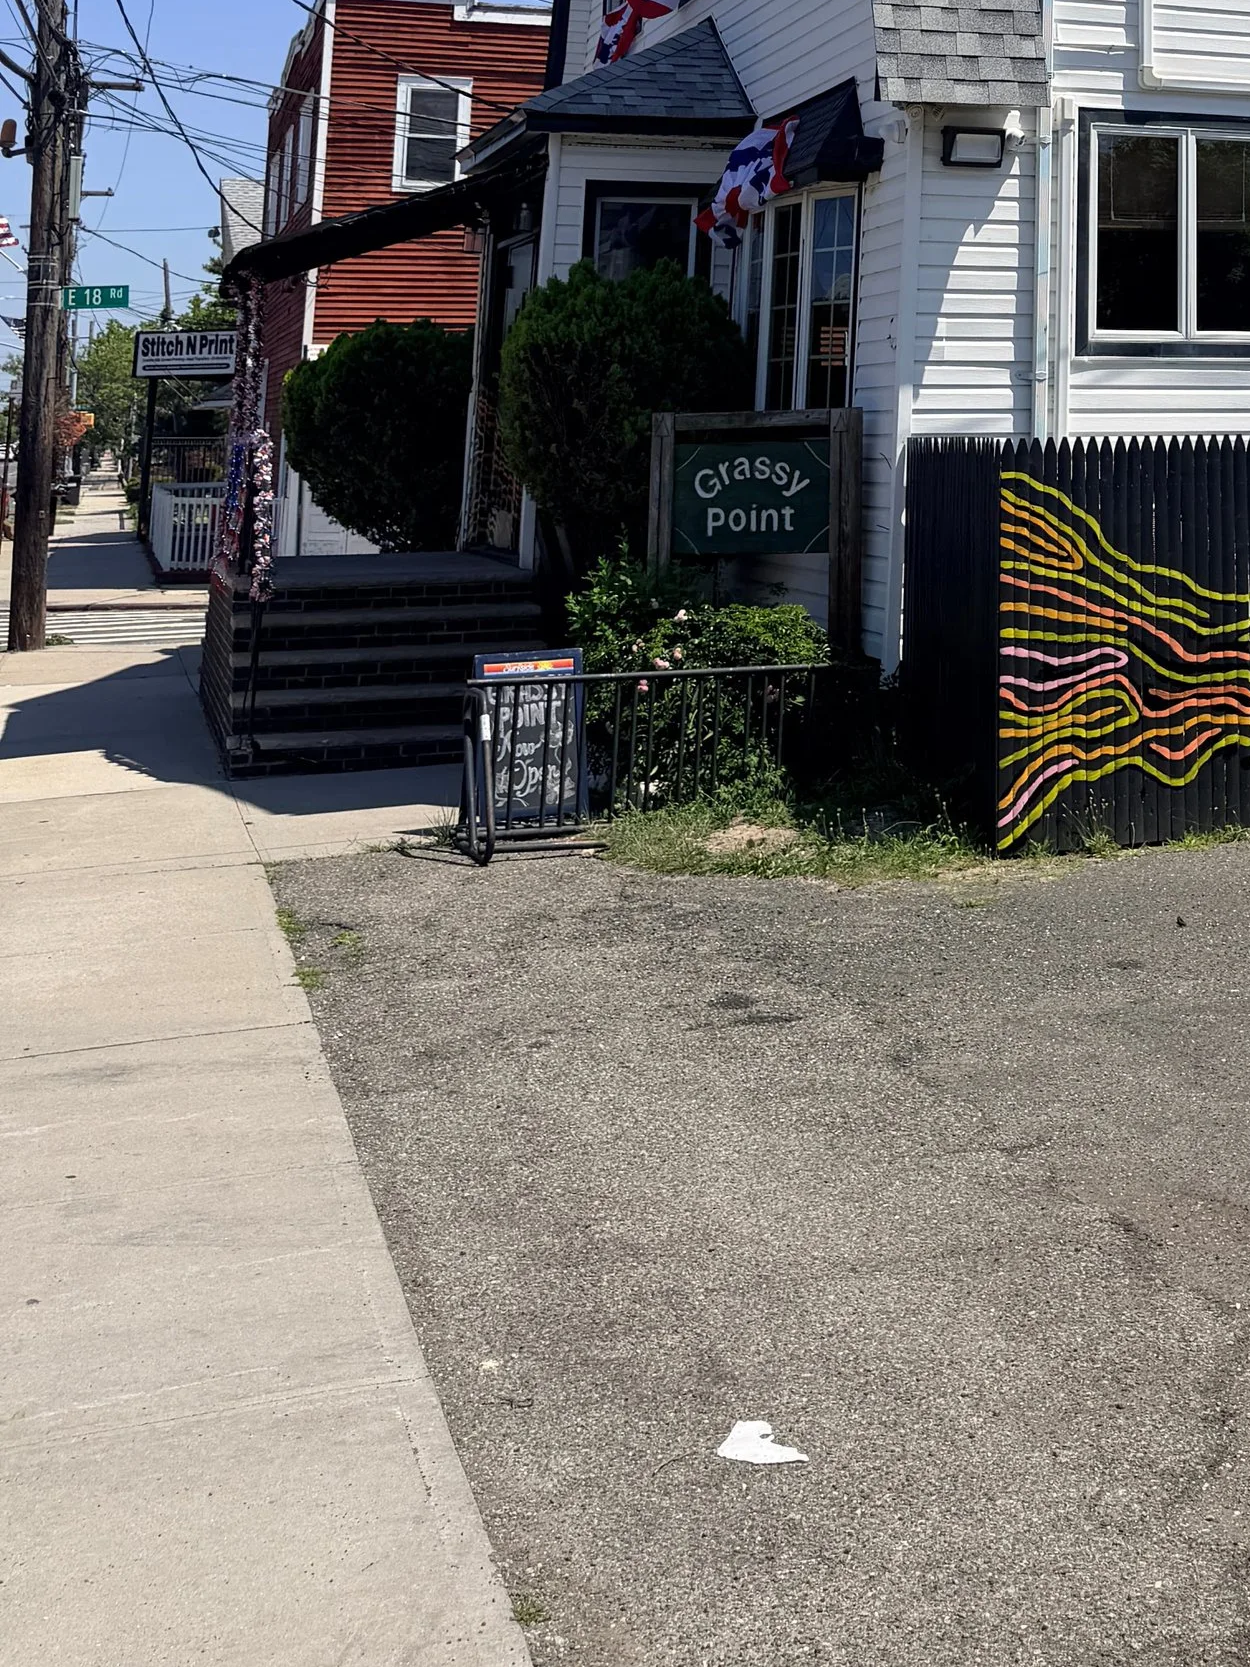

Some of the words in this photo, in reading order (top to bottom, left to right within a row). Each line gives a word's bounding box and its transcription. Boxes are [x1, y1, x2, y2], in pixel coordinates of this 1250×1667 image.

[68, 289, 77, 306] E
[84, 288, 102, 306] 18
[110, 287, 123, 299] Rd
[141, 335, 184, 358] Stitch
[186, 335, 198, 356] N
[199, 333, 235, 356] Print
[694, 456, 811, 499] Grassy
